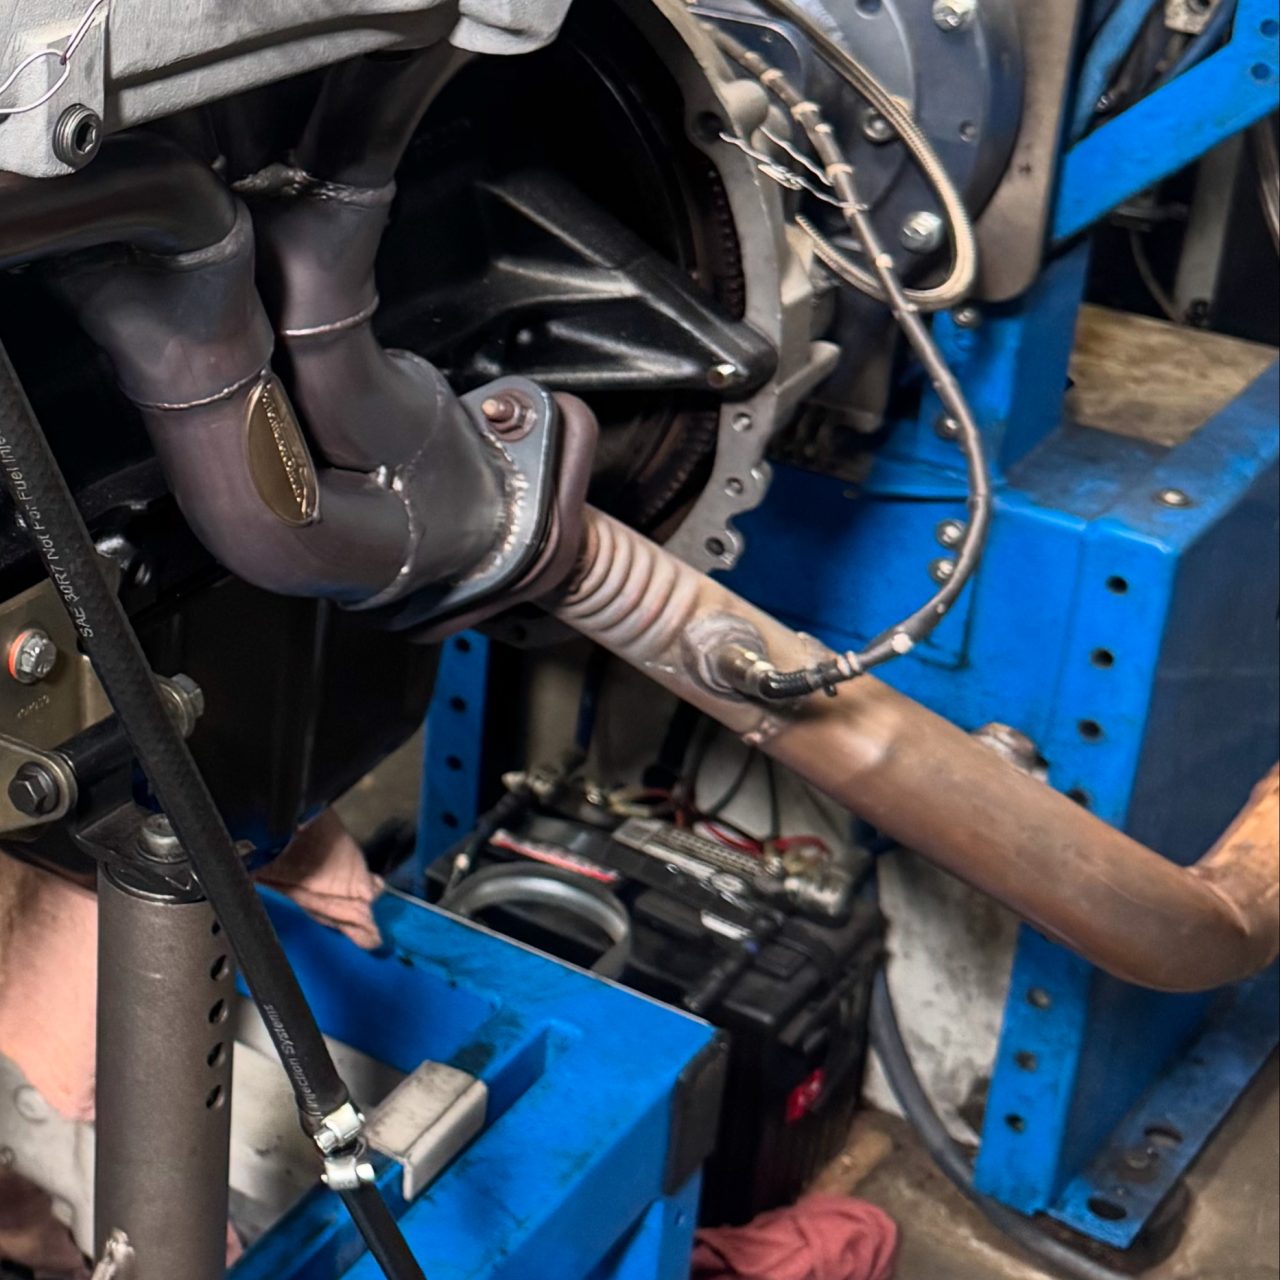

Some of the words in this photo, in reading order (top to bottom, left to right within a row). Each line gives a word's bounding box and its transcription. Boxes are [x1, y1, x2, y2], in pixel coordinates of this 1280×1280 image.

[6, 467, 33, 501] Fuel
[51, 565, 80, 603] 30R7
[69, 607, 94, 638] SAE
[263, 1003, 295, 1055] Systems
